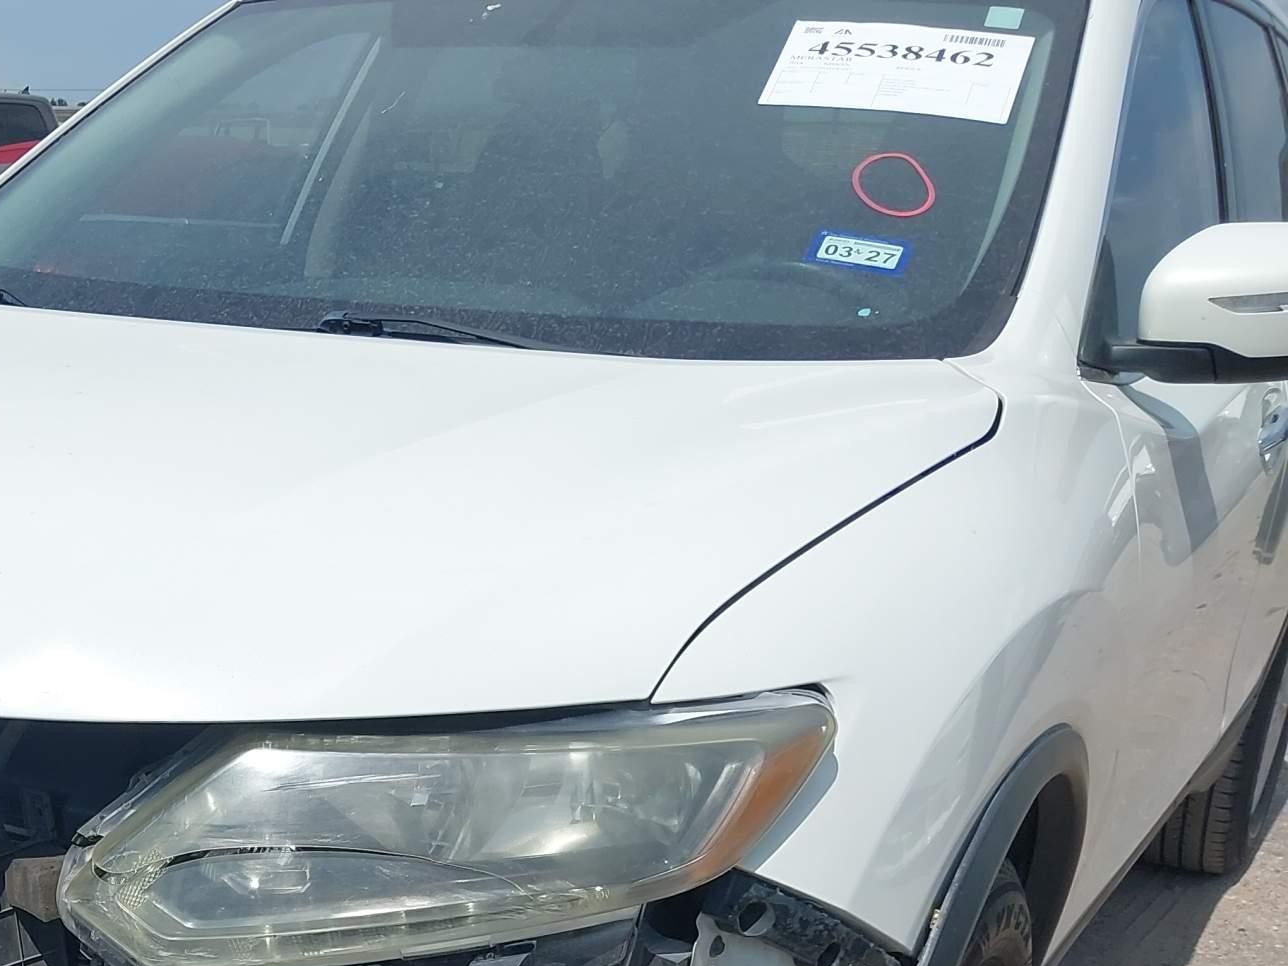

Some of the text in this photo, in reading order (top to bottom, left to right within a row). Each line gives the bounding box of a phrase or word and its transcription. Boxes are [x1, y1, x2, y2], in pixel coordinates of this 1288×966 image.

[808, 41, 994, 67] 45538462
[824, 244, 853, 258] 03
[864, 250, 897, 264] 27
